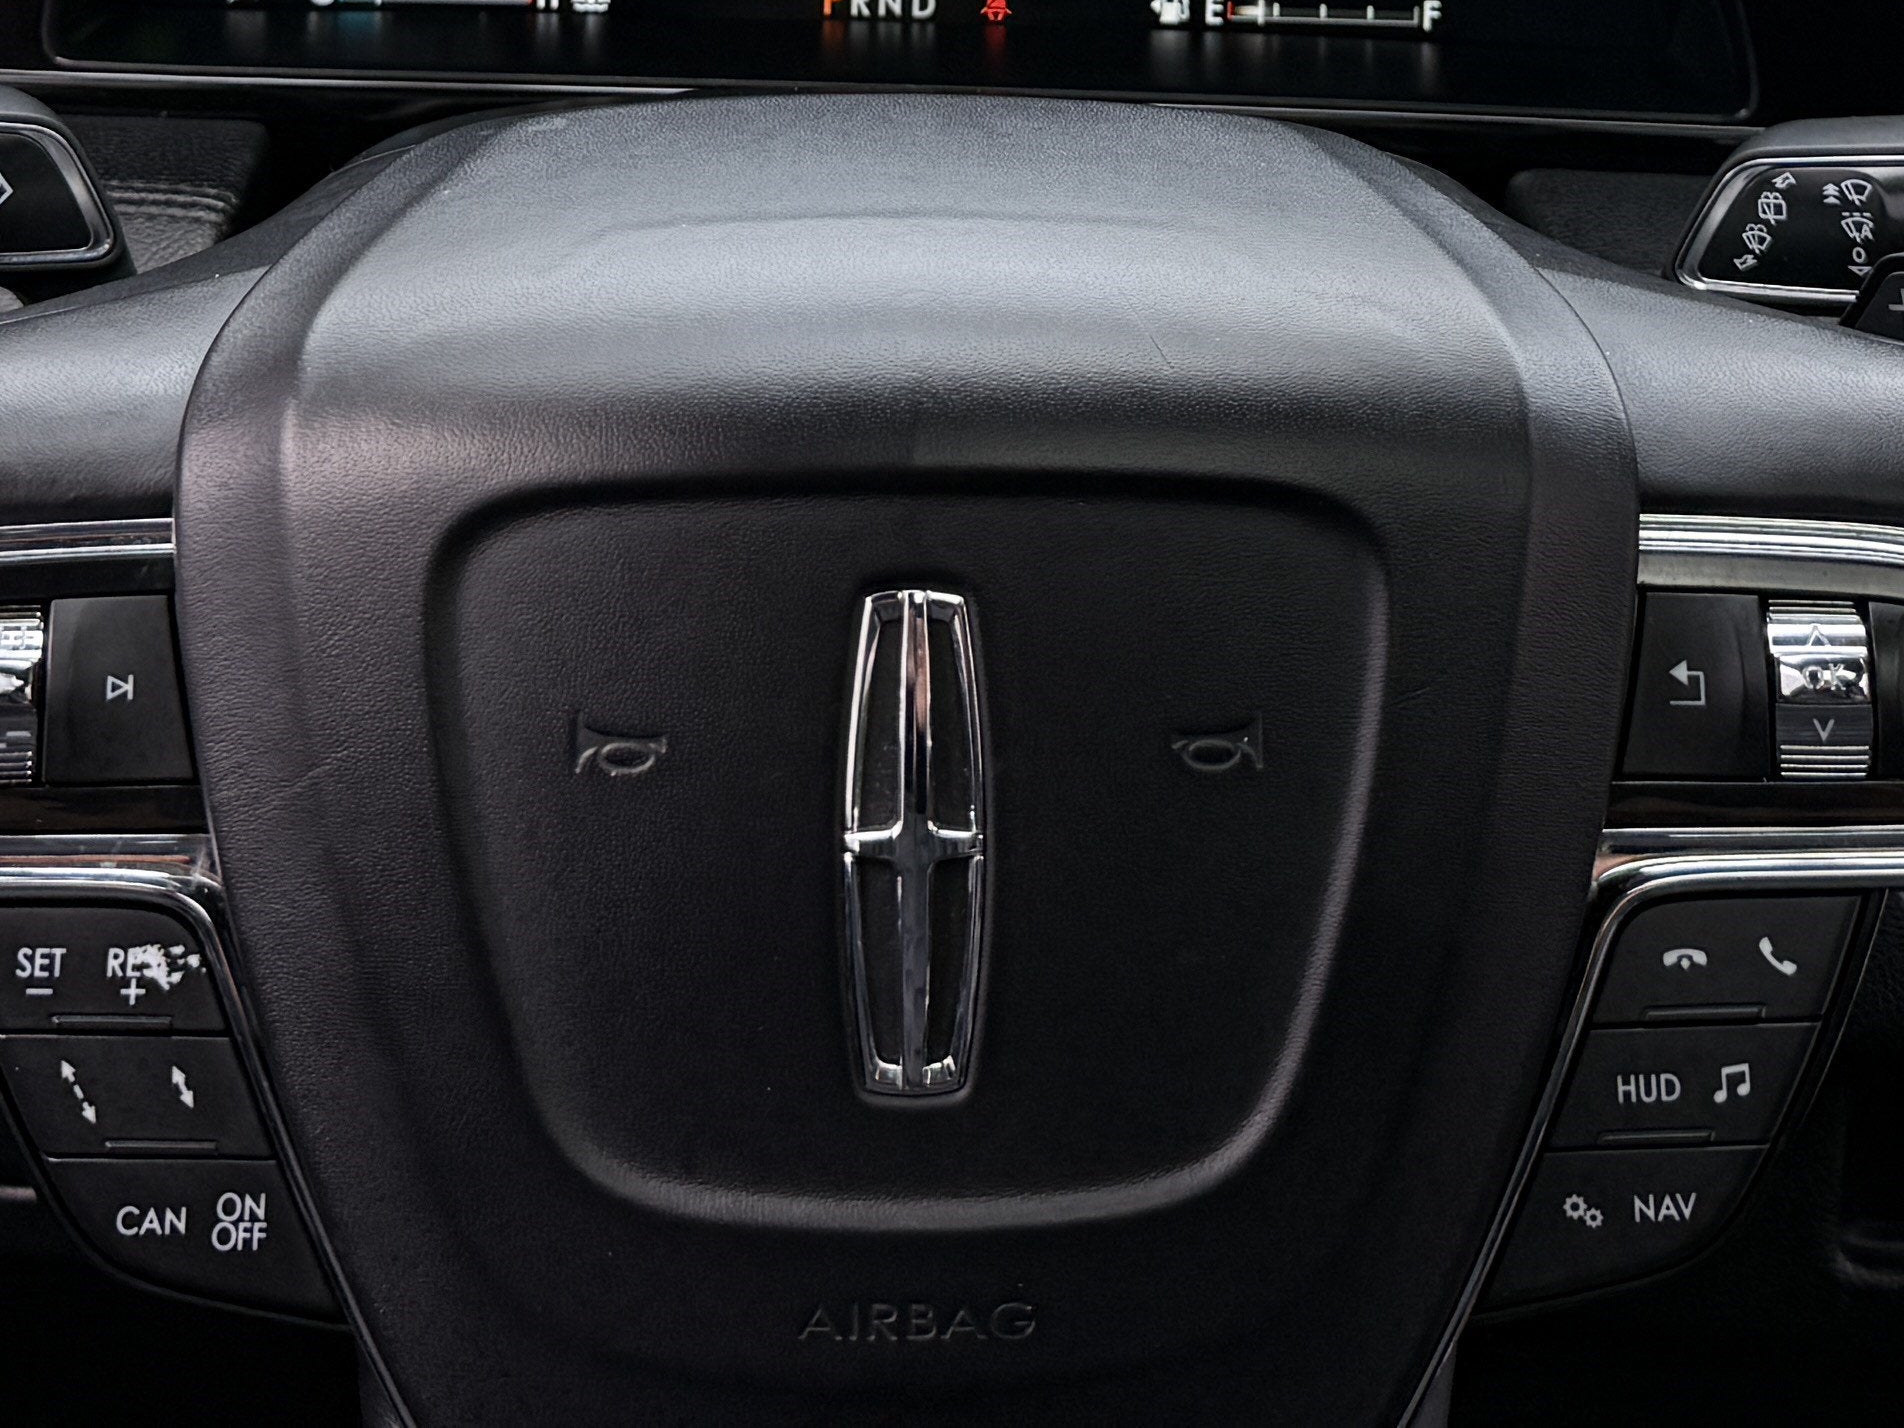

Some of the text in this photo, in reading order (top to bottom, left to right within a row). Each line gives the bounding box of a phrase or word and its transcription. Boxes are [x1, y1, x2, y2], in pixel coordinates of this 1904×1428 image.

[1422, 0, 1444, 33] F
[15, 947, 69, 980] SET
[1616, 1073, 1683, 1106] HUD
[116, 1205, 189, 1238] CAN
[216, 1191, 267, 1222] ON
[1633, 1192, 1698, 1225] NAV
[211, 1221, 269, 1252] OFF
[797, 1300, 1038, 1343] AIRBAG
